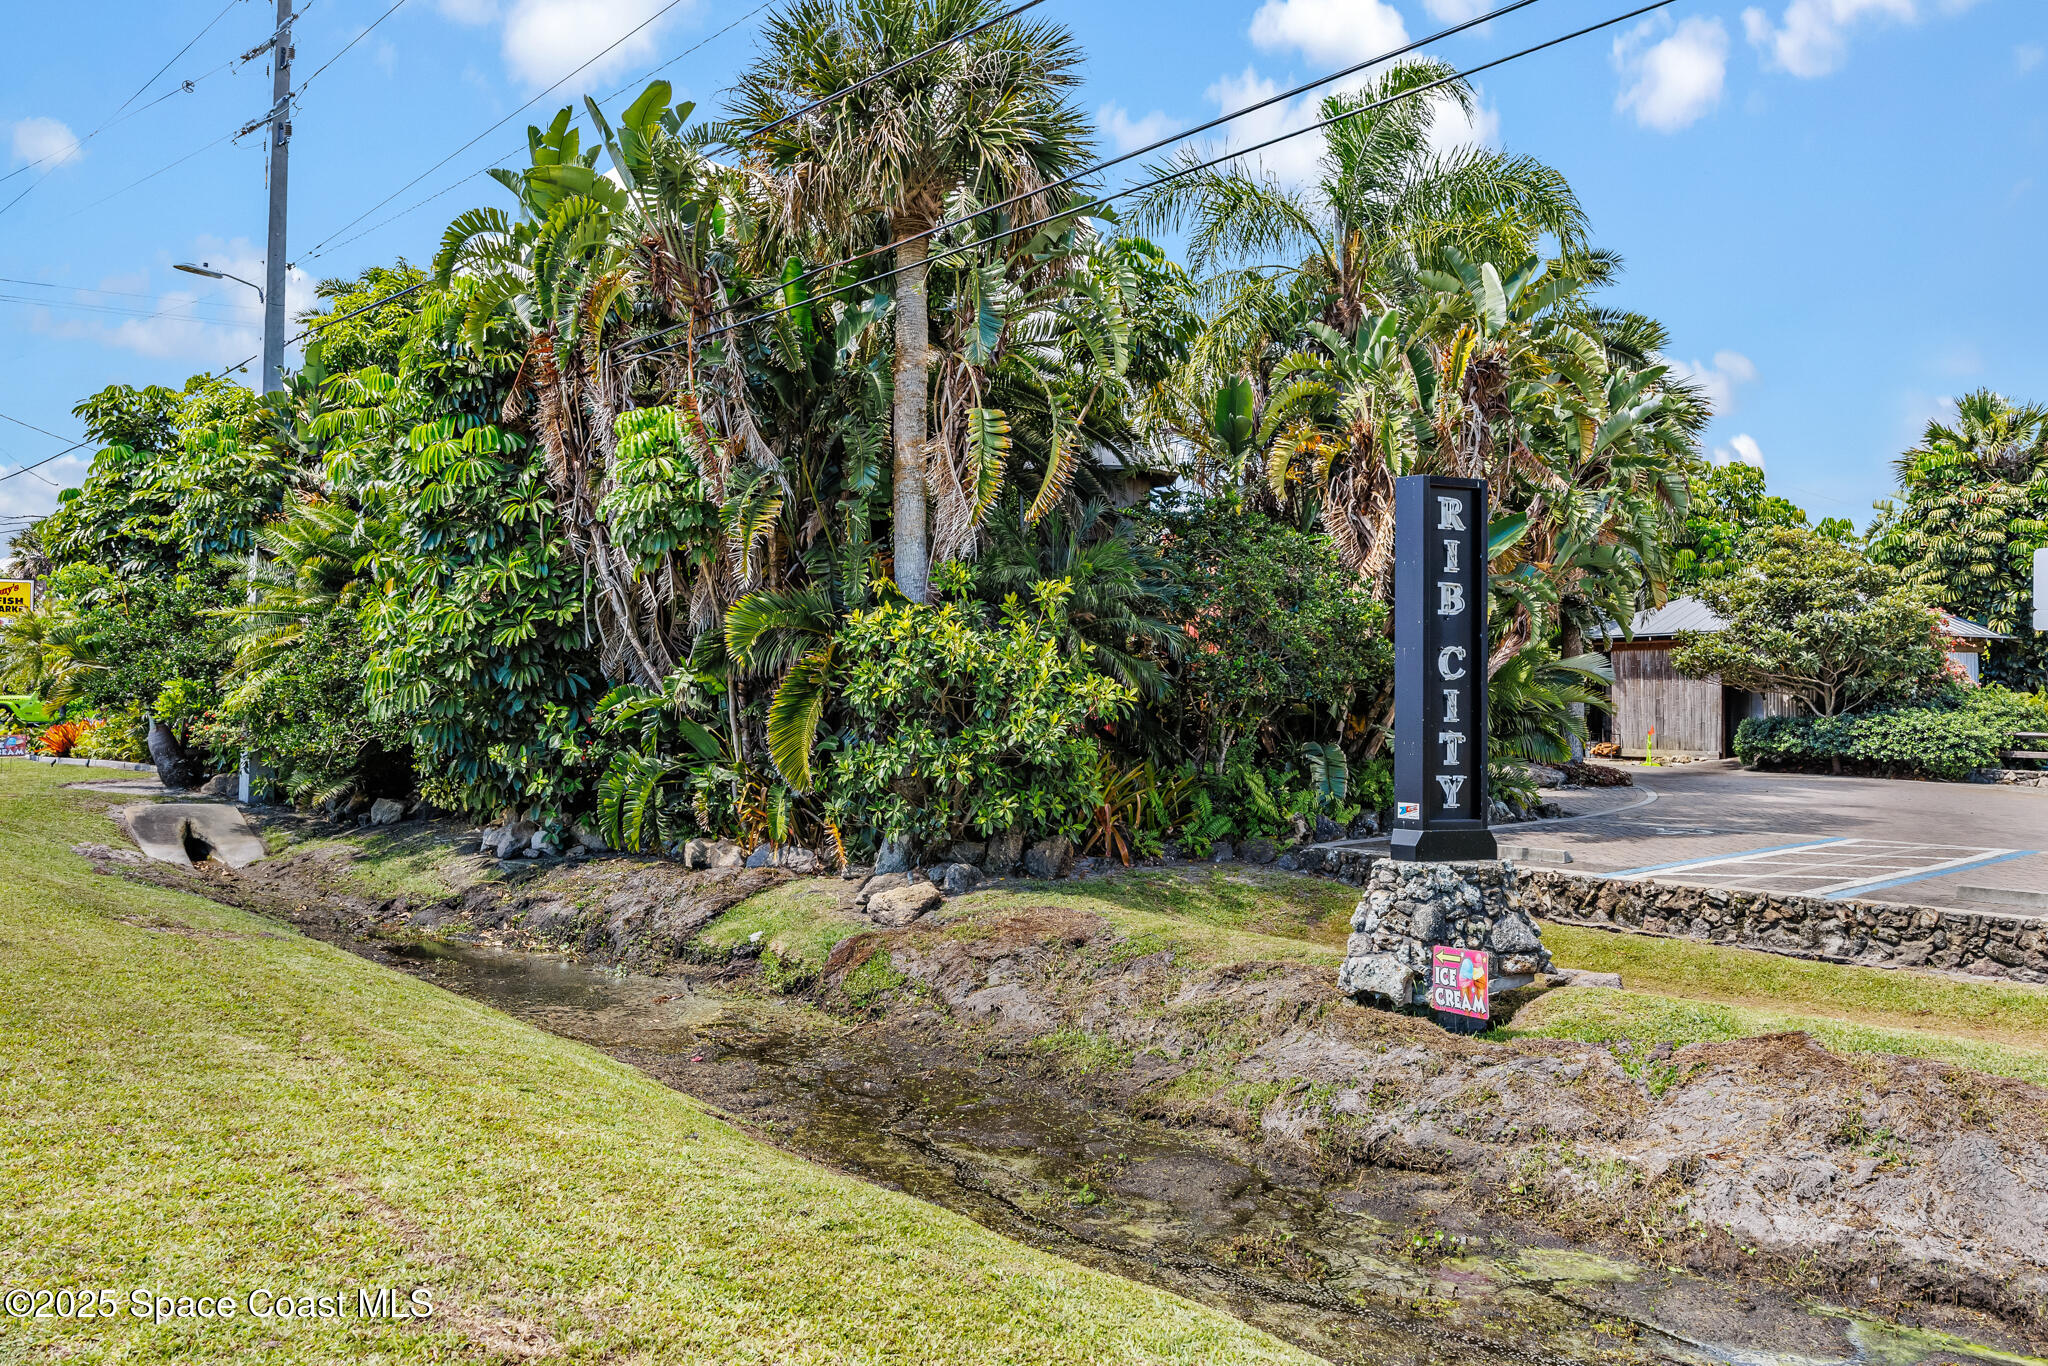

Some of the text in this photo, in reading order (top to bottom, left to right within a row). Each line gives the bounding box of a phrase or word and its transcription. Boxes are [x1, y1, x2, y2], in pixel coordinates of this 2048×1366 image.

[1435, 495, 1468, 810] RIB CITY
[0, 748, 25, 756] EAM
[1434, 966, 1458, 988] ICE
[1434, 987, 1487, 1014] CREAM
